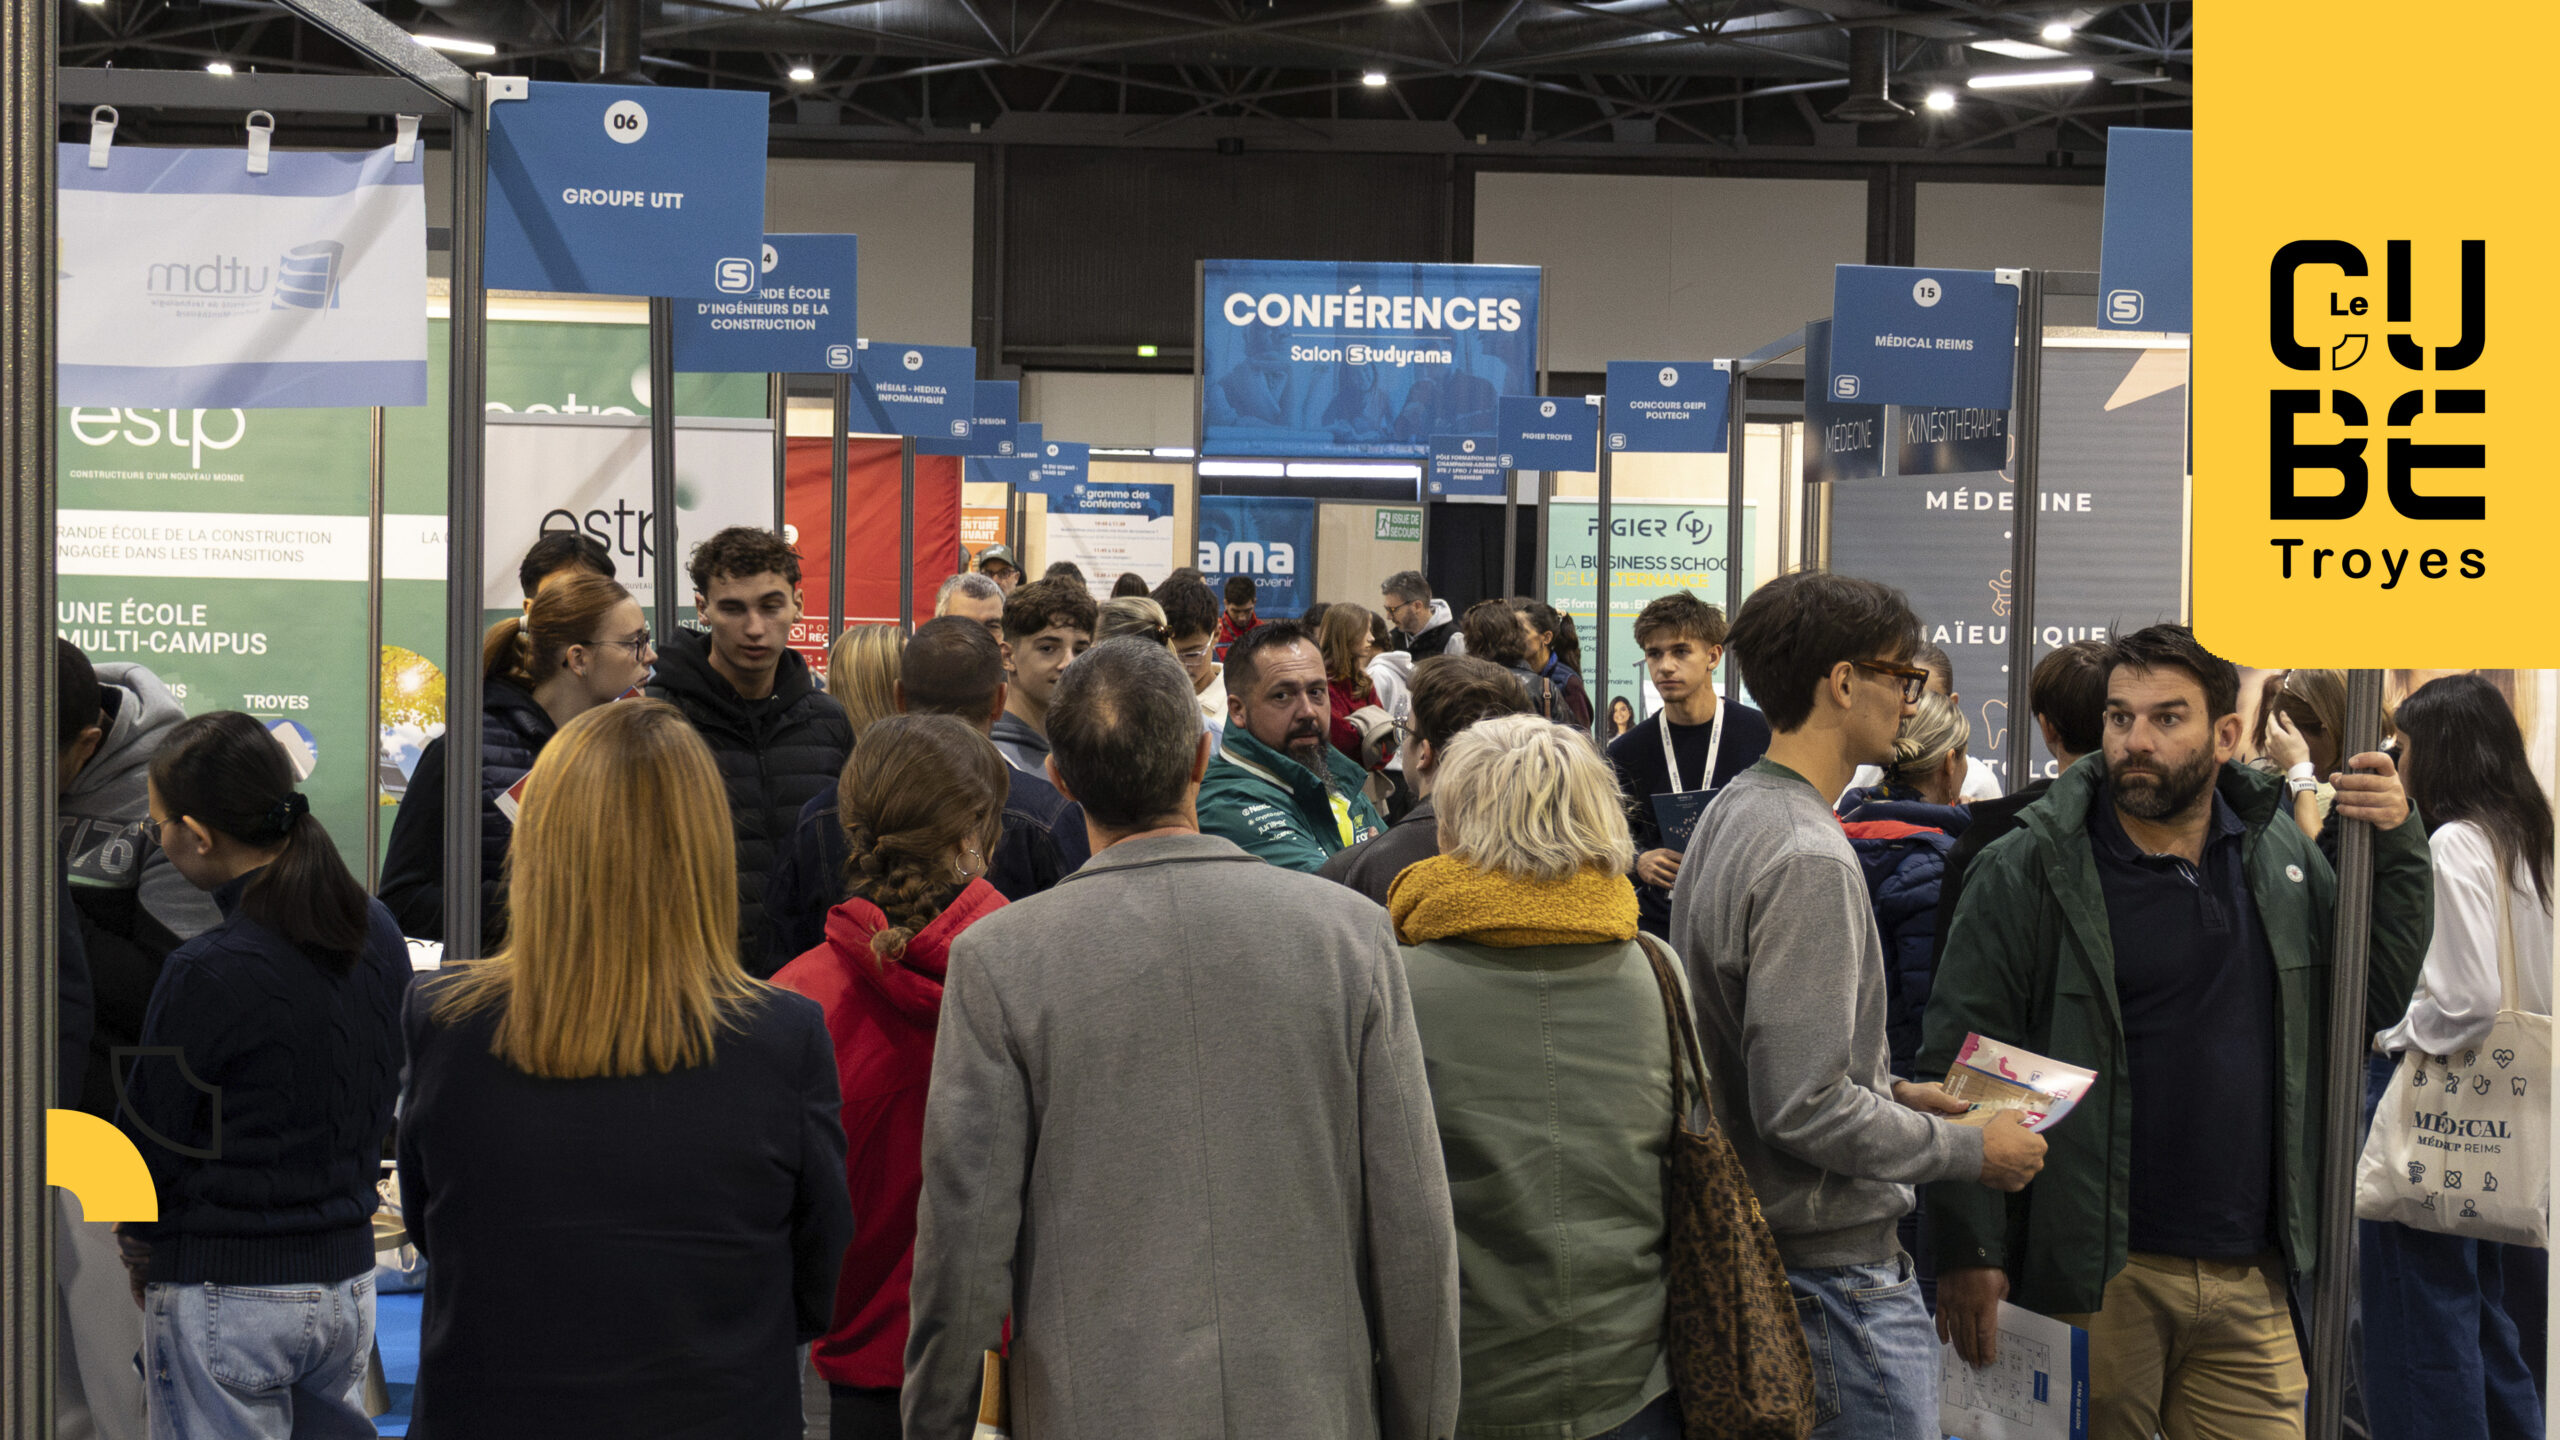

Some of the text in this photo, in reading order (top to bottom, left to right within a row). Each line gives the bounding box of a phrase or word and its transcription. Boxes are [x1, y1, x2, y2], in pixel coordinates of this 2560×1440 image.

[613, 113, 639, 130] 06
[562, 188, 684, 209] GROUPE UTT
[762, 252, 772, 264] 4
[759, 286, 831, 300] NDE ÉCOLE
[1919, 287, 1936, 298] 15
[698, 301, 829, 316] D'INGÉNIEURS DE LA
[1223, 285, 1522, 333] CONFÉRENCES
[711, 318, 816, 331] CONSTRUCTION
[1875, 333, 1974, 351] MÉDICAL REIMS
[907, 356, 919, 365] 20
[1290, 344, 1453, 368] Salon Studyrama
[1662, 373, 1674, 381] 21
[878, 394, 945, 405] INFORMATIQUE
[1630, 400, 1681, 410] CONCOURS
[1646, 411, 1690, 420] POLYTECH
[1547, 433, 1573, 441] TROYES
[1825, 418, 1873, 453] MÉDECINE
[70, 469, 246, 482] CONSTRUCTEURS D'UN NOUVEAU MONDE
[1132, 490, 1150, 499] des
[1926, 486, 2093, 513] MÉDEINE
[1079, 499, 1142, 510] conférences
[961, 519, 1000, 530] ENTURE
[1391, 513, 1420, 525] ISSUE DE
[56, 524, 332, 544] RANDE ÉCOLE DE LA CONSTRUCTION
[1389, 526, 1421, 539] SECOURS
[1588, 518, 1668, 537] PGIER
[421, 531, 441, 544] LA
[57, 545, 305, 563] NGAGÉE DANS LES TRANSITIONS
[1555, 555, 1577, 569] LA
[1670, 557, 1743, 571] SCHOO
[1554, 571, 1577, 586] DE
[1555, 598, 1571, 609] 25
[1634, 600, 1651, 610] BT
[58, 598, 208, 626] UNE ÉCOLE
[1921, 620, 2107, 649] AÏEUIQUE
[243, 694, 310, 710] TROYES
[2464, 1143, 2502, 1154] REIMS
